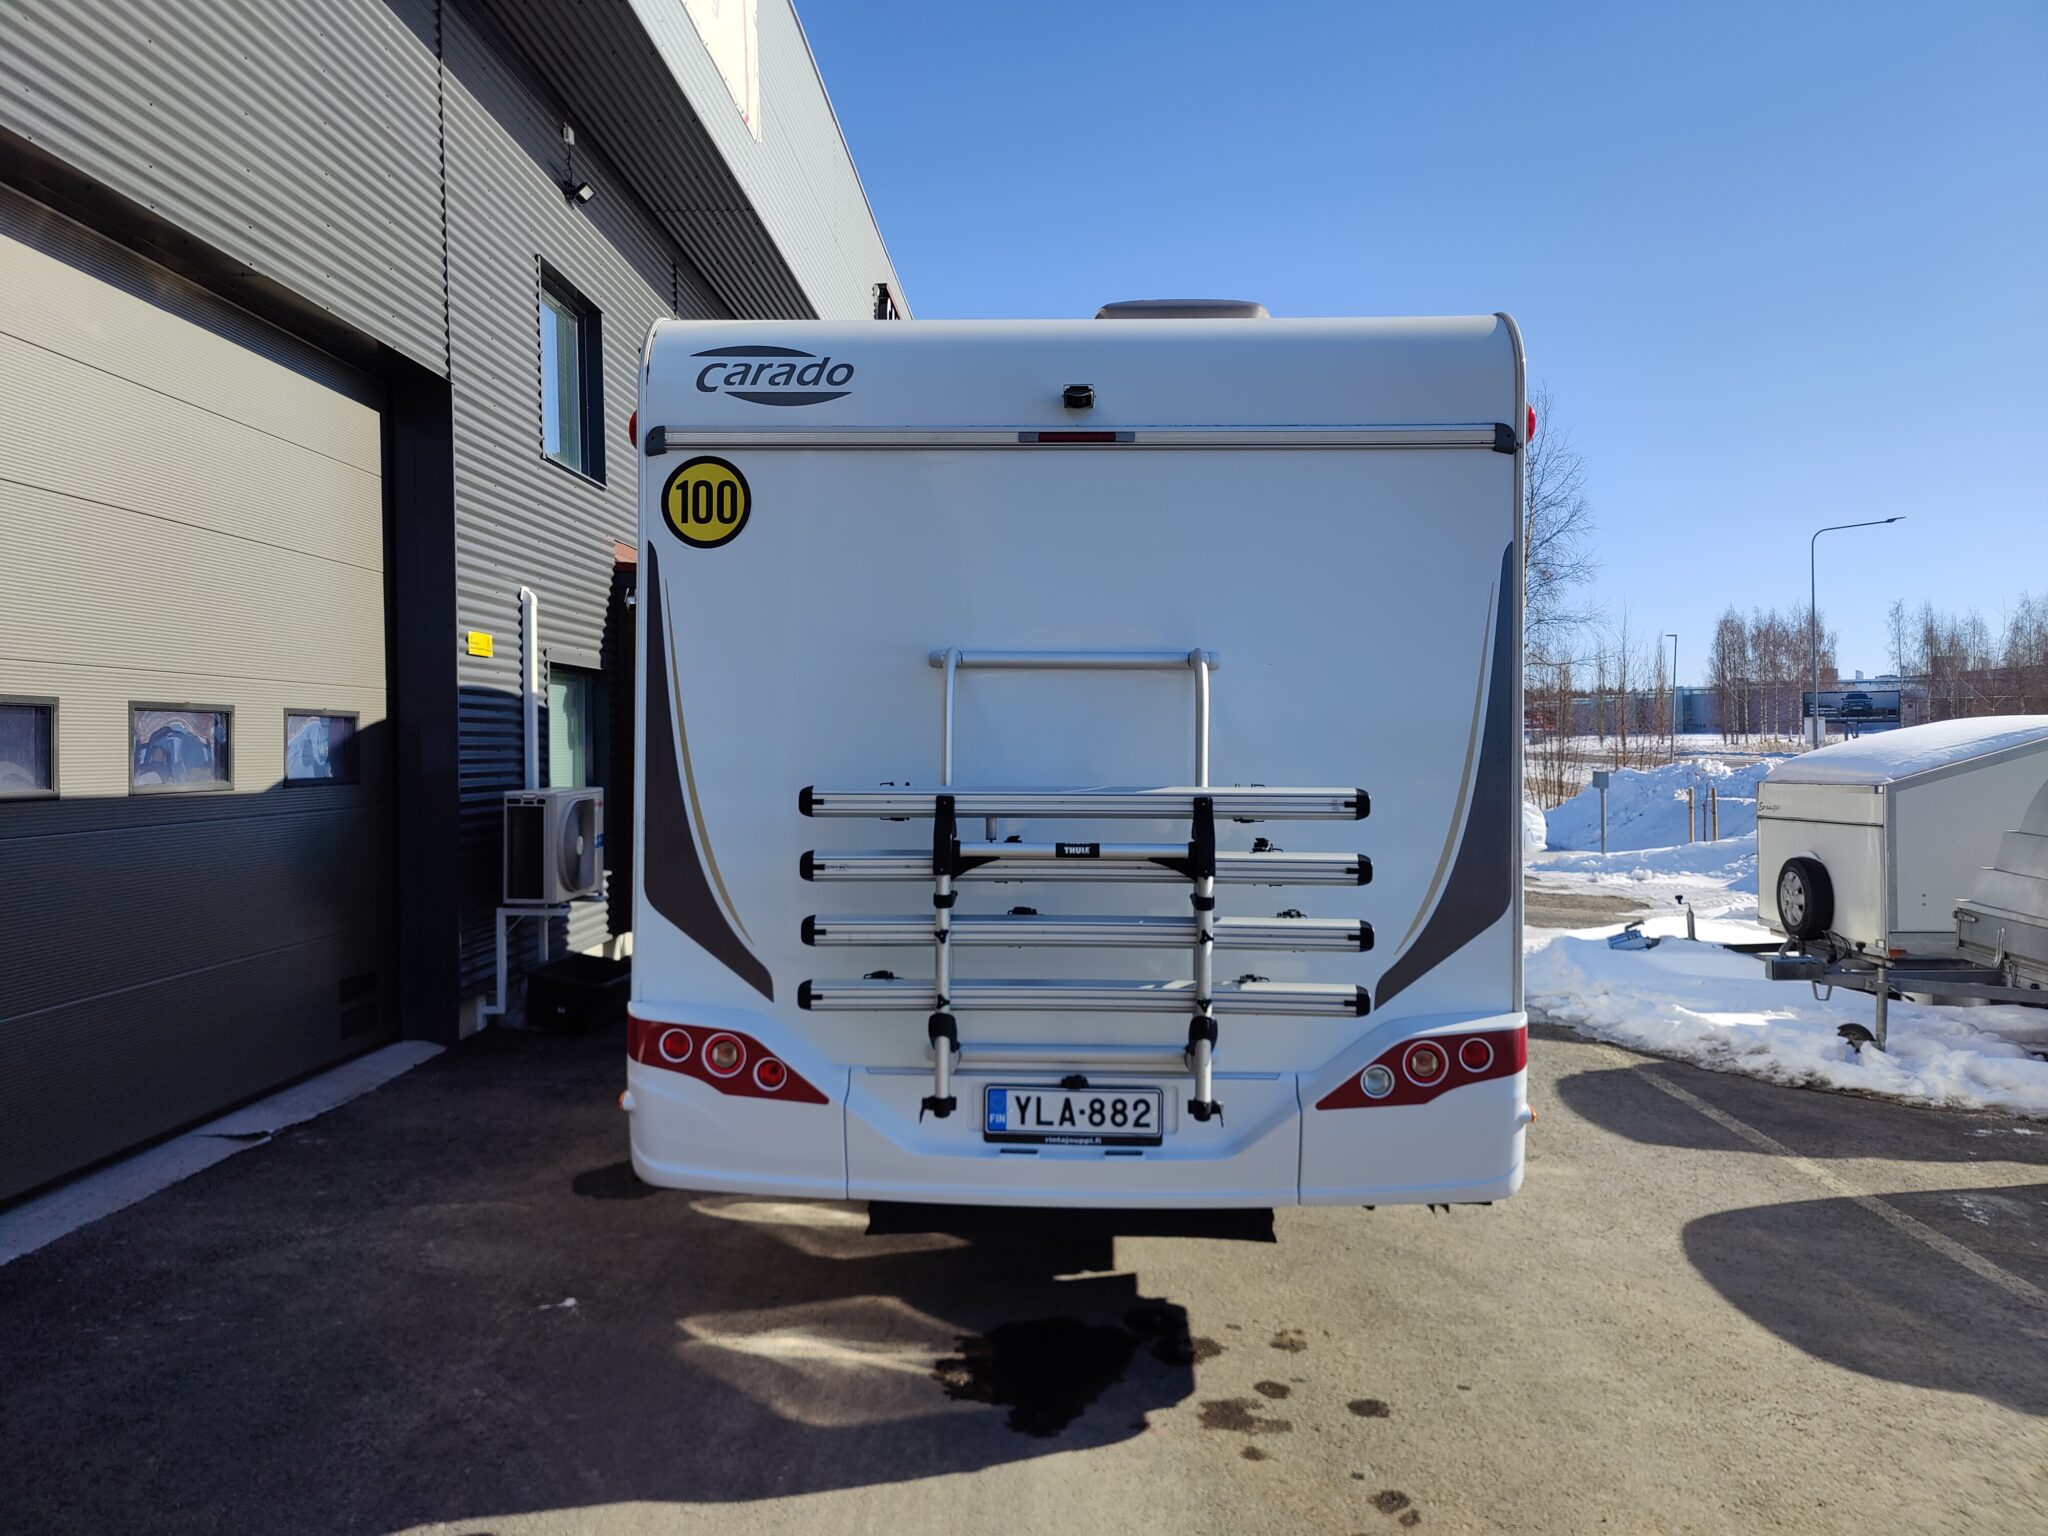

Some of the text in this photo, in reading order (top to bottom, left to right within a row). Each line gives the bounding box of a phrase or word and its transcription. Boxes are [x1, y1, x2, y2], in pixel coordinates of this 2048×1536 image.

[675, 479, 738, 525] 100
[1063, 846, 1091, 855] THULE
[989, 1113, 1006, 1124] FIN
[1014, 1095, 1151, 1128] YLA-882
